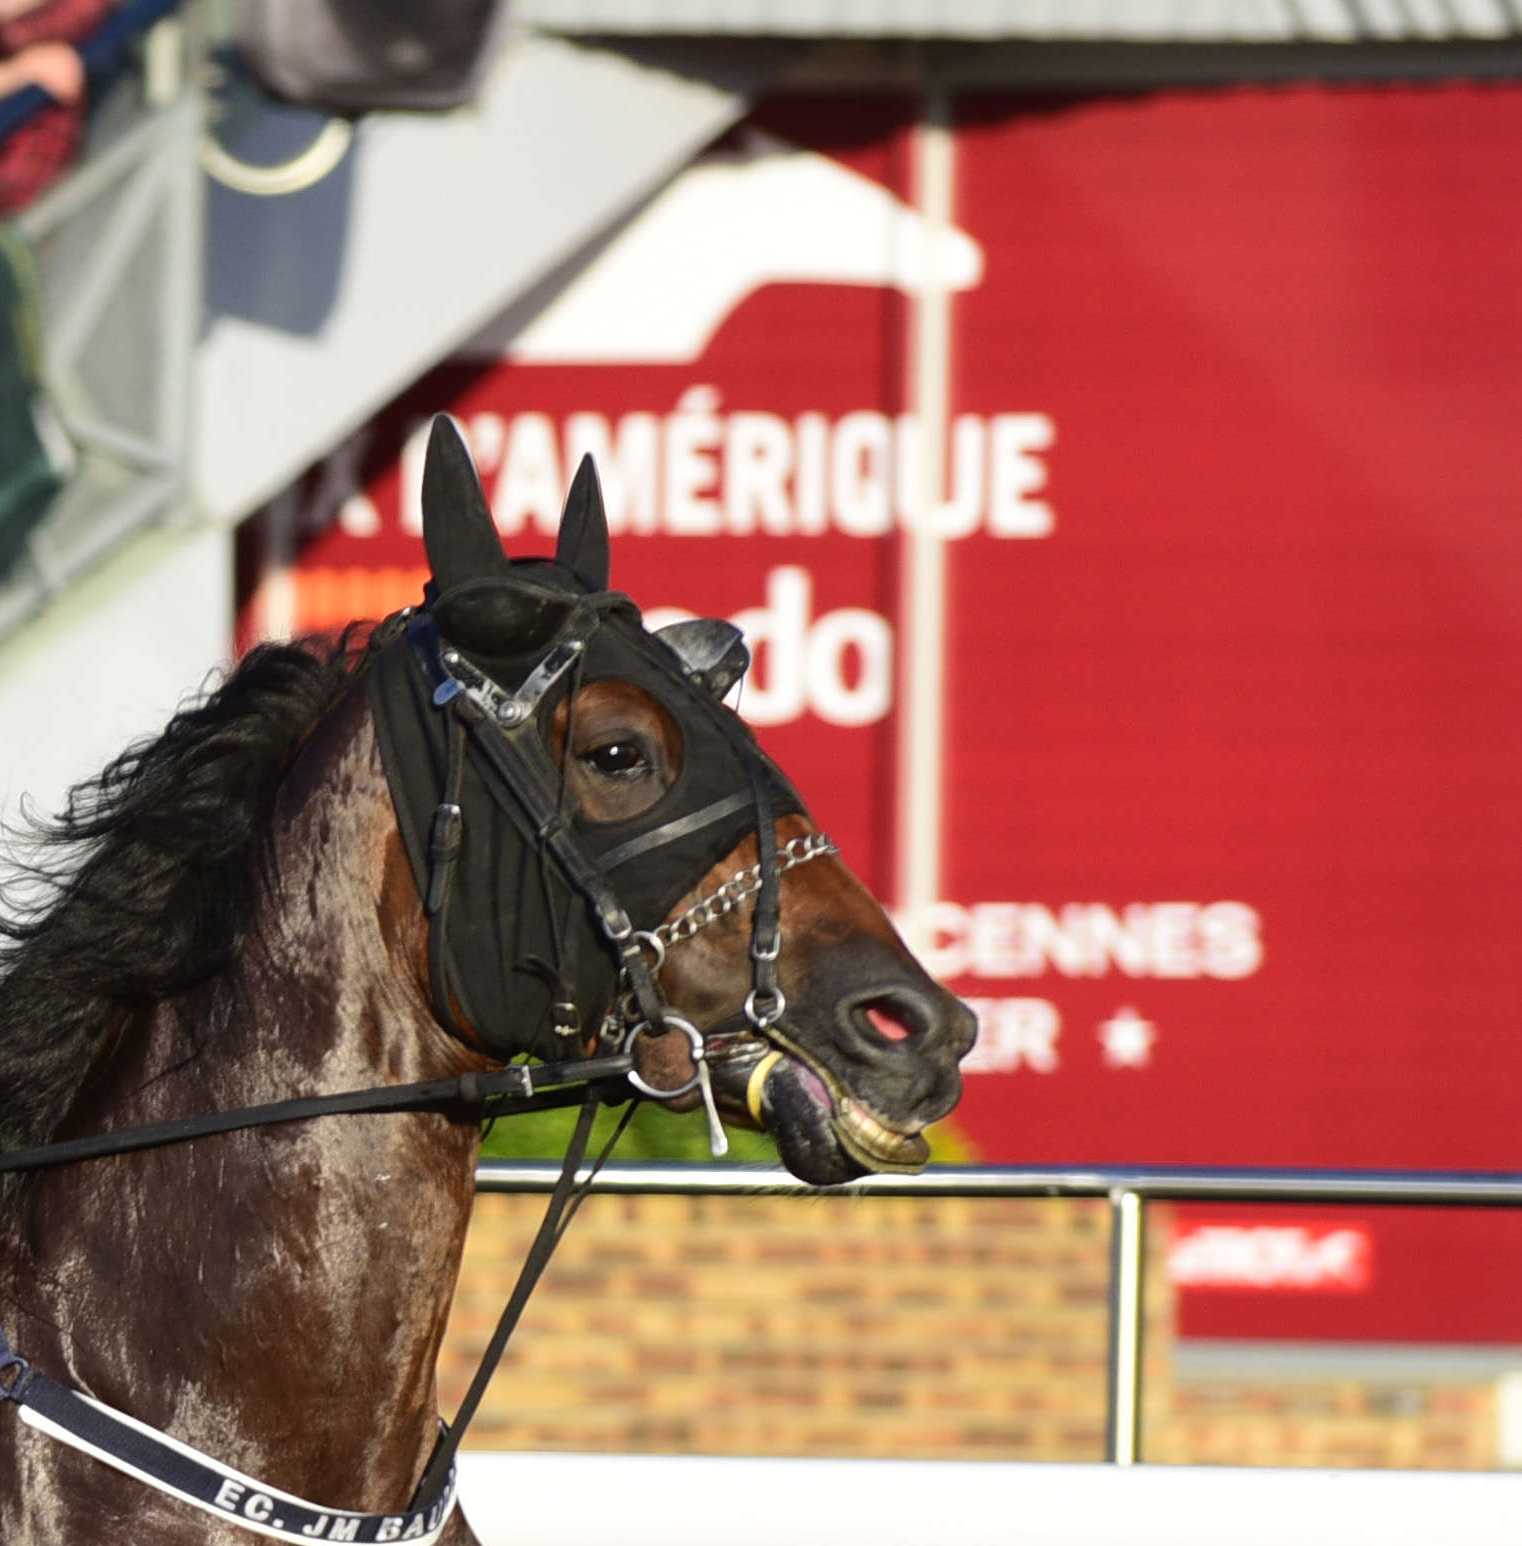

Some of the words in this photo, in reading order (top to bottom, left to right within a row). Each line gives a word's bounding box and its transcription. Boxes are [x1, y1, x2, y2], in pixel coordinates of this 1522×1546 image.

[895, 900, 1263, 980] CENNES
[213, 1478, 285, 1529] EC.
[302, 1514, 362, 1542] JM
